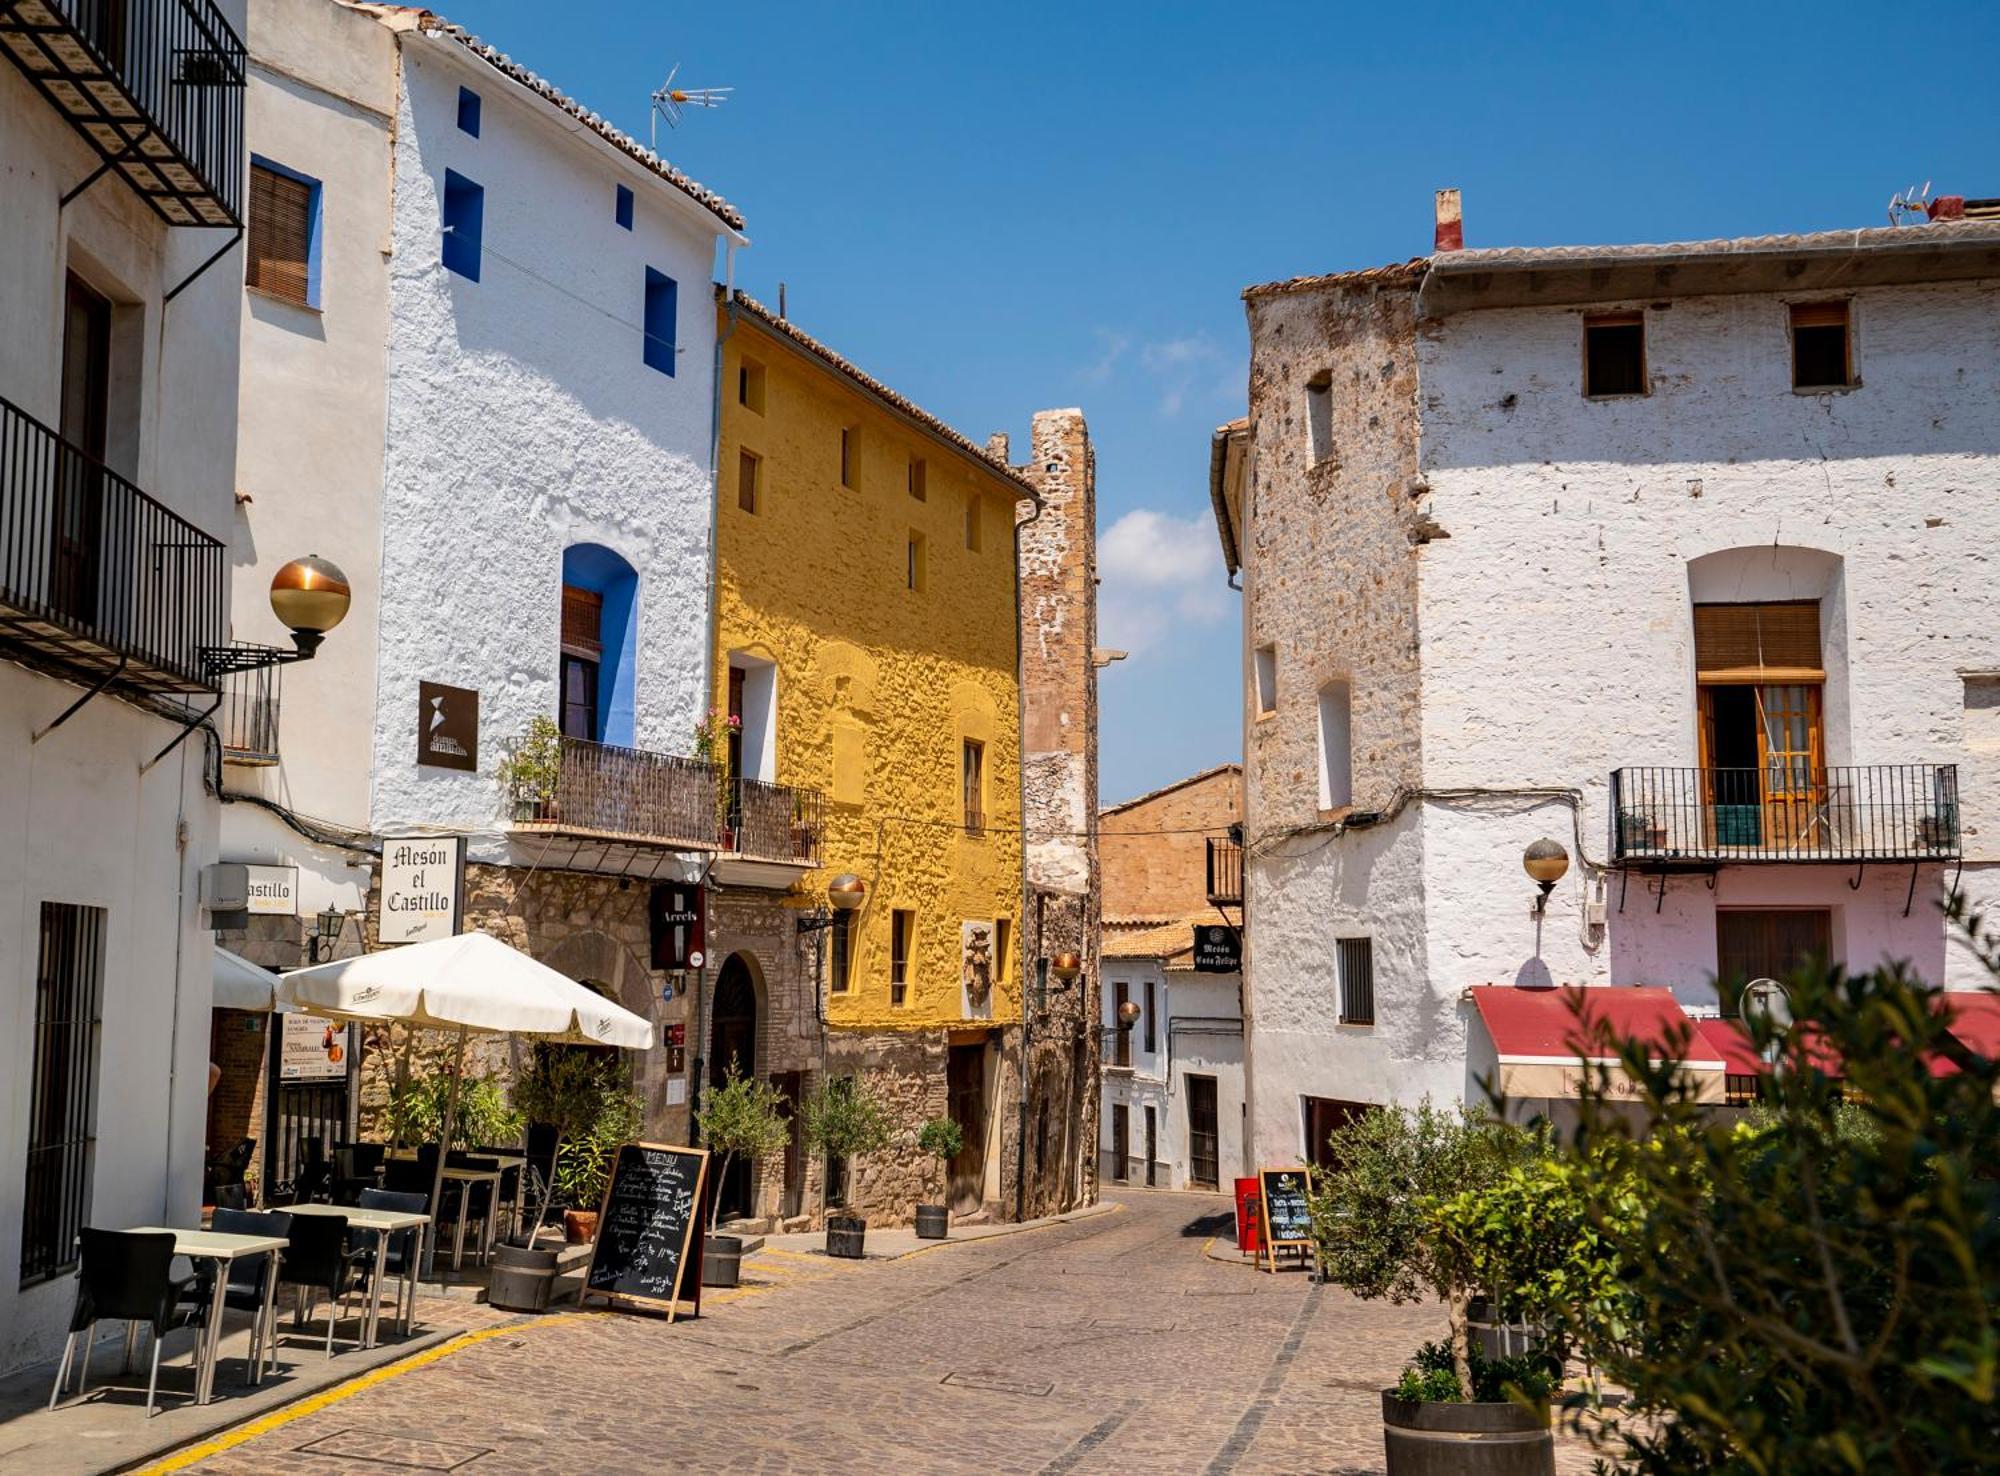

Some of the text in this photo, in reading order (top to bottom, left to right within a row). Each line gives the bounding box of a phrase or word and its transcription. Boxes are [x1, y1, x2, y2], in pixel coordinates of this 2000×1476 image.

[392, 843, 447, 868] Mesón
[412, 870, 425, 888] el
[247, 882, 290, 899] astillo
[387, 891, 449, 912] Castillo
